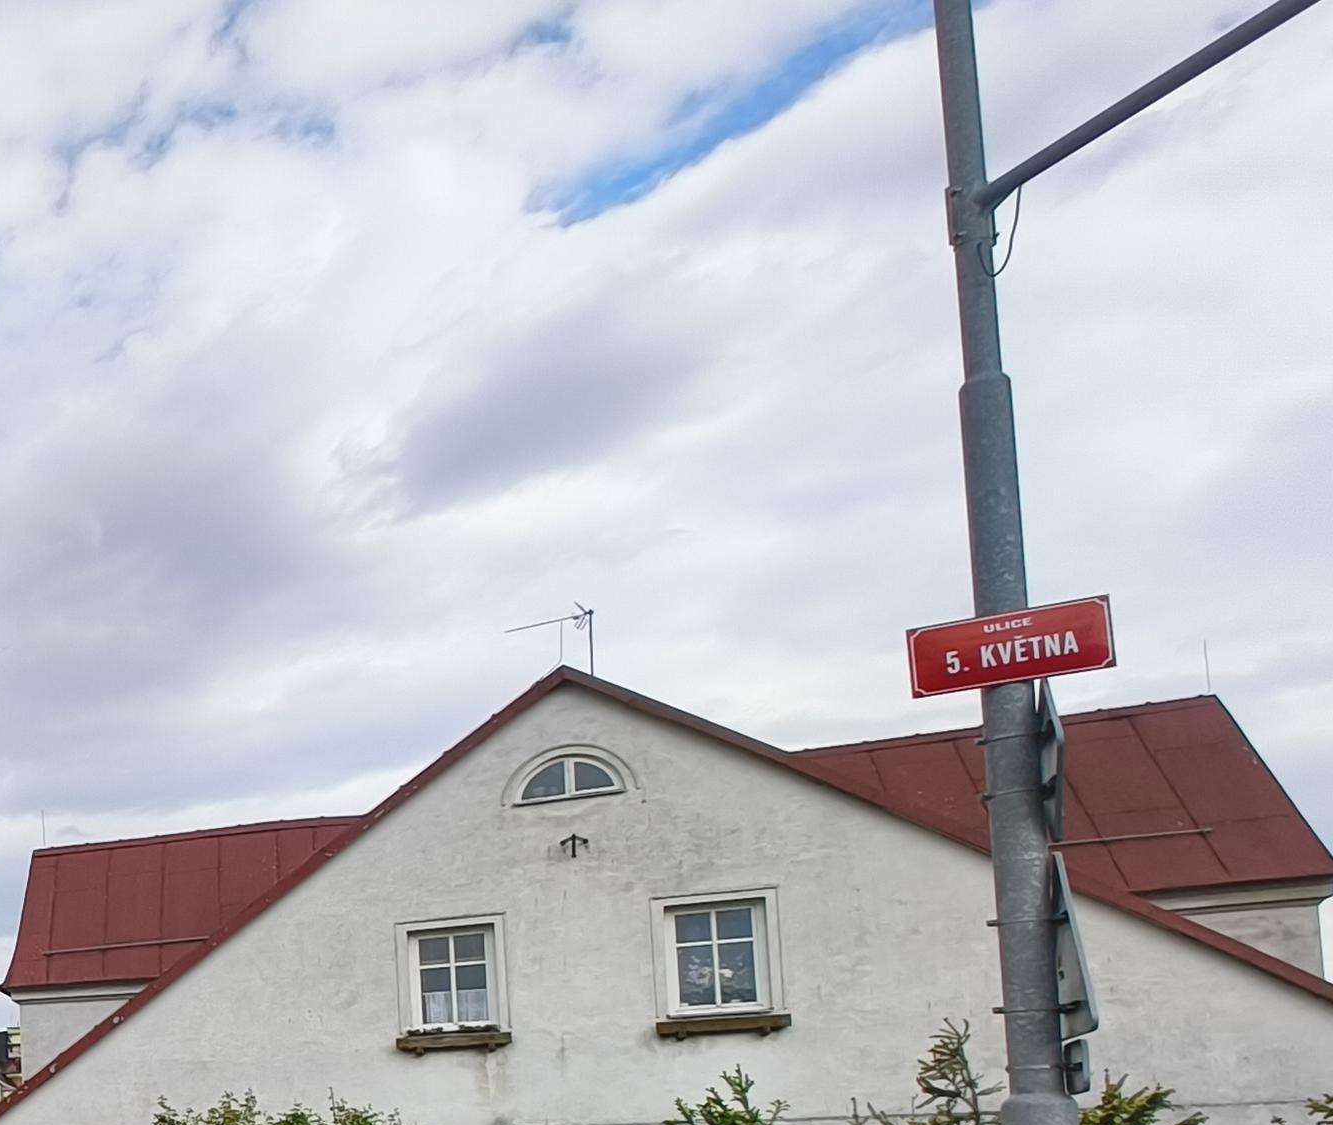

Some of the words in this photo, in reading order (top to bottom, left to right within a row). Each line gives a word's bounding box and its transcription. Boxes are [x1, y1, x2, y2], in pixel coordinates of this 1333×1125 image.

[983, 617, 1033, 633] ULICE
[945, 651, 970, 674] 5.
[980, 630, 1079, 668] KVĚTNA
